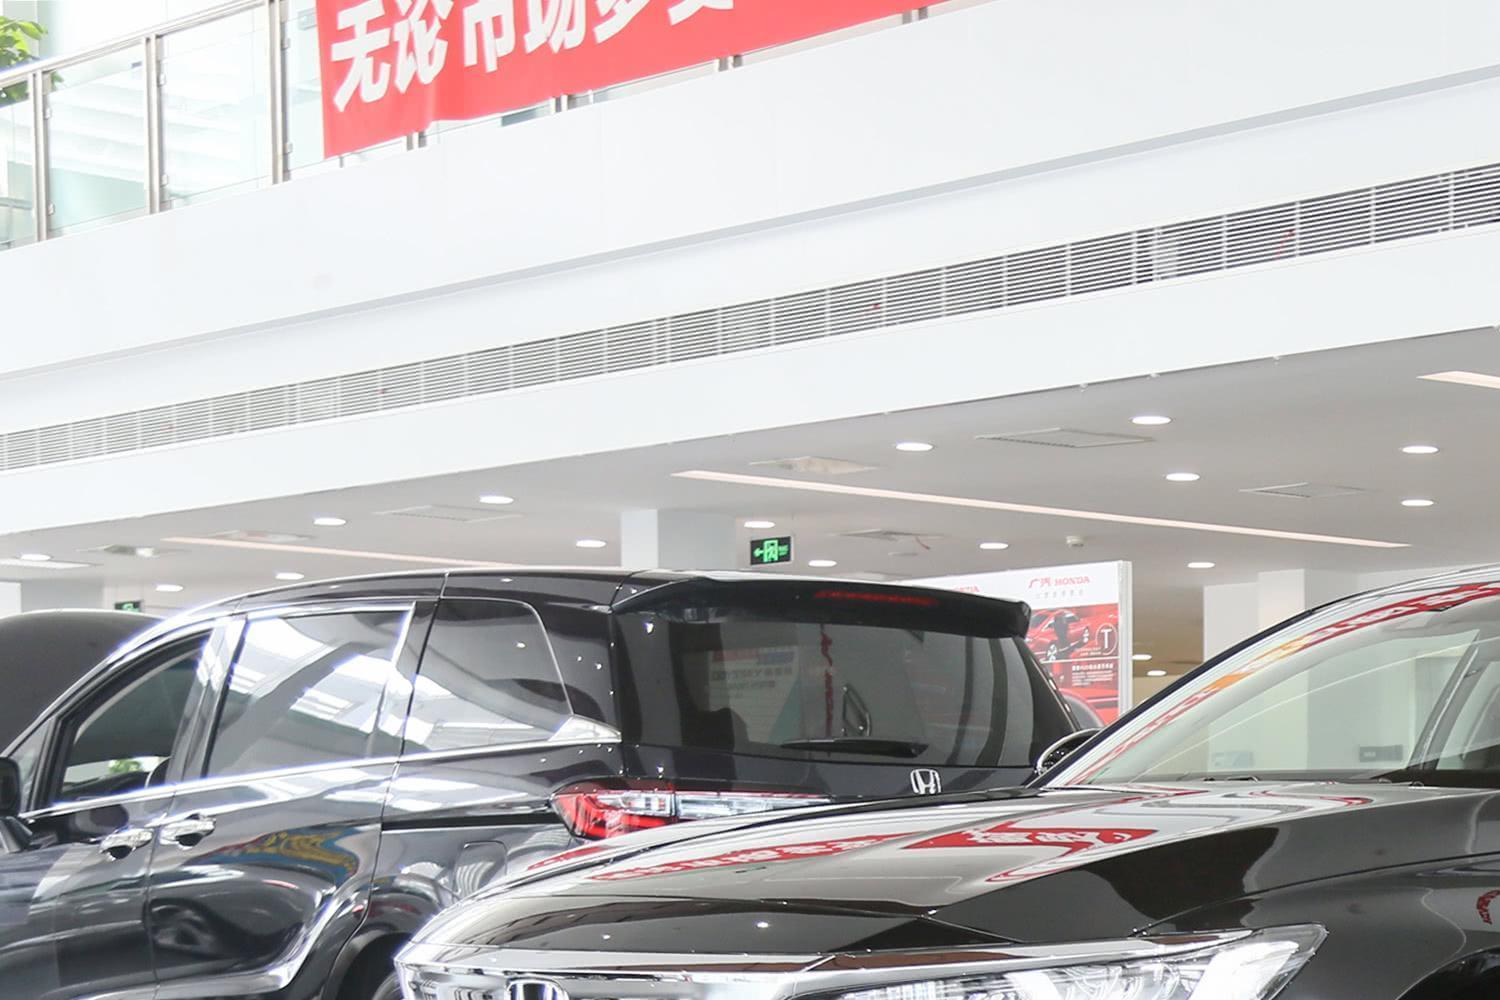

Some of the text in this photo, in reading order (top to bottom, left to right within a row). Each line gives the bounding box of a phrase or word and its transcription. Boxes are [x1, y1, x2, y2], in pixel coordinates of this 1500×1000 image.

[331, 0, 736, 113] 无论市场多
[1054, 575, 1091, 586] HONDA
